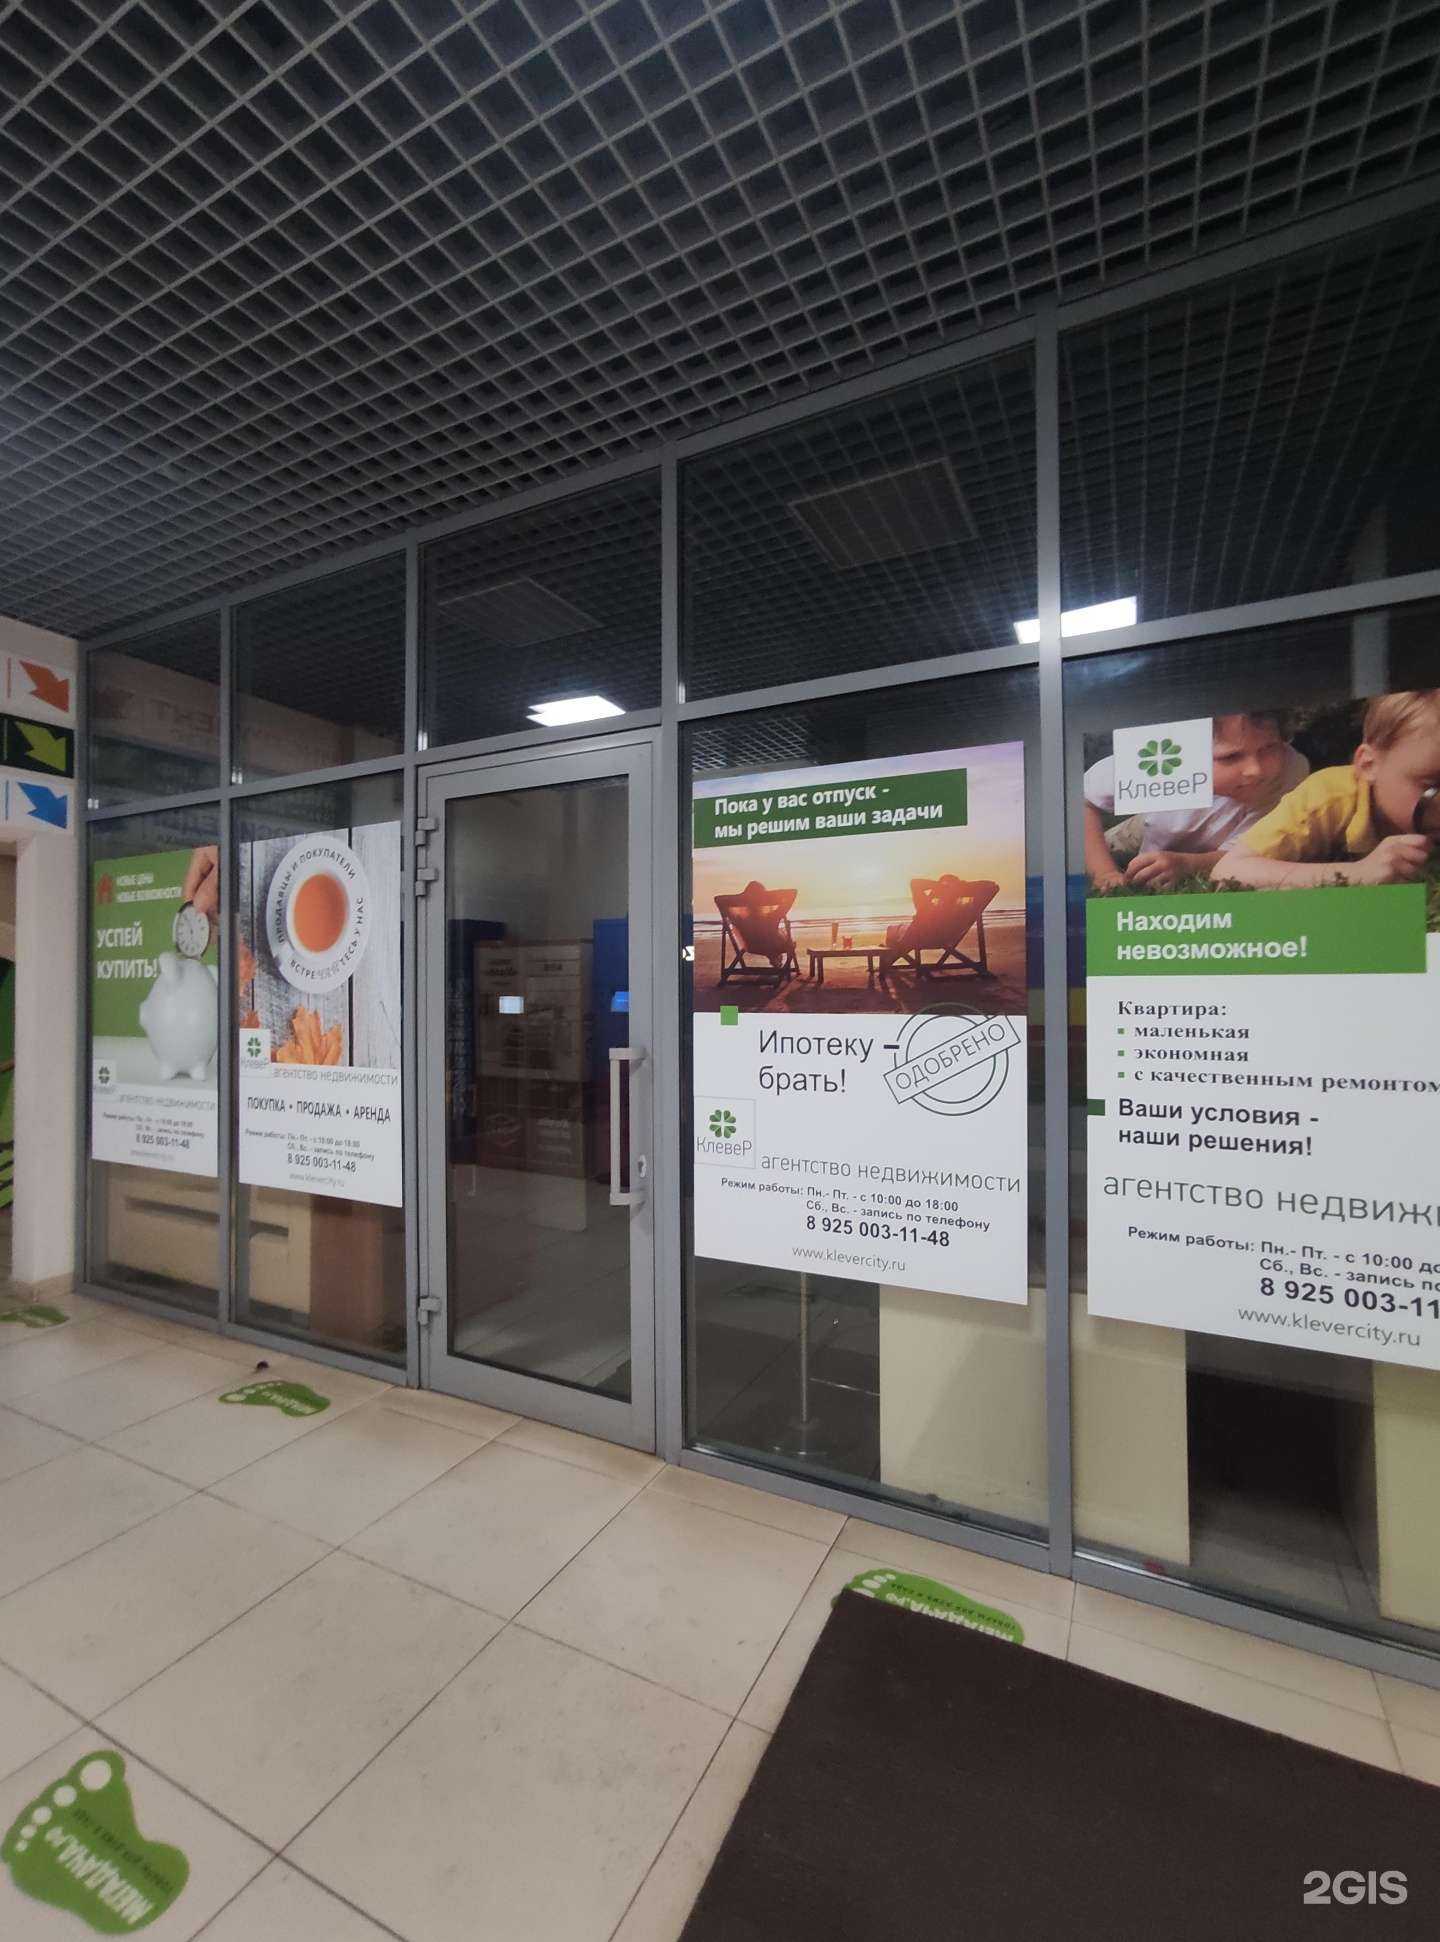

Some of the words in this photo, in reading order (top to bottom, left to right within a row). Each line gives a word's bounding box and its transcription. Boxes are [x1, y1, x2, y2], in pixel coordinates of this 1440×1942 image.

[1118, 772, 1208, 800] КлевеР
[715, 799, 757, 815] Пока
[762, 798, 773, 815] у
[778, 794, 808, 809] вас
[812, 785, 877, 807] отпуск
[715, 824, 742, 838] мы
[747, 817, 810, 840] решим
[815, 812, 866, 829] ваши
[871, 804, 944, 825] задачи
[300, 848, 356, 880] ПОКУПАТЕЛИ
[97, 921, 143, 947] УСПЕЙ
[1117, 910, 1233, 933] Находим
[1117, 936, 1308, 960] невозможное!
[97, 959, 158, 979] КУПИТЬ!
[1118, 1000, 1227, 1020] Квартира:
[1134, 1026, 1250, 1039] маленькая
[759, 1030, 874, 1063] Ипотеку
[895, 1023, 1006, 1090] ОДОБРЕНО
[1134, 1049, 1249, 1062] экономная
[759, 1065, 846, 1096] брать!
[1134, 1070, 1144, 1081] с
[1151, 1071, 1313, 1088] качественным
[1322, 1076, 1440, 1093] ремонтом
[248, 1097, 285, 1112] ПОКУПКА
[297, 1101, 341, 1118] ПРОДАЖА
[354, 1106, 391, 1124] АРЕНДА
[1119, 1098, 1183, 1119] Ваши
[1191, 1106, 1300, 1126] условия
[696, 1136, 752, 1156] КлевеР
[1119, 1129, 1180, 1146] наши
[1189, 1133, 1312, 1156] решения!
[287, 1153, 293, 1163] 8
[295, 1154, 311, 1166] 925
[313, 1157, 357, 1173] 003-11-48
[761, 1155, 850, 1176] агентство
[858, 1164, 1020, 1193] недвижимости
[721, 1177, 755, 1189] Режим
[758, 1182, 804, 1195] работы:
[833, 1189, 849, 1200] Пт.
[871, 1193, 902, 1205] 10:00
[905, 1199, 921, 1208] до
[926, 1199, 959, 1212] 18:00
[1104, 1176, 1263, 1209] агентство
[806, 1215, 816, 1230] 8
[822, 1217, 853, 1235] 925
[859, 1221, 950, 1247] 003-11-48
[831, 1203, 849, 1214] Вс.
[860, 1207, 903, 1220] запись
[906, 1213, 922, 1222] по
[926, 1215, 990, 1232] телефону
[792, 1246, 906, 1272] www.klevercity.ru
[1128, 1226, 1180, 1242] Режим
[1186, 1235, 1255, 1251] работы:
[1302, 1246, 1327, 1260] Пт.
[1346, 1254, 1355, 1264] с
[1362, 1253, 1413, 1270] 10:00
[1300, 1263, 1328, 1278] Вс.
[1346, 1271, 1415, 1289] запись
[1260, 1277, 1275, 1296] 8
[1285, 1281, 1334, 1304] 925
[1238, 1308, 1421, 1346] www.klevercity.ru
